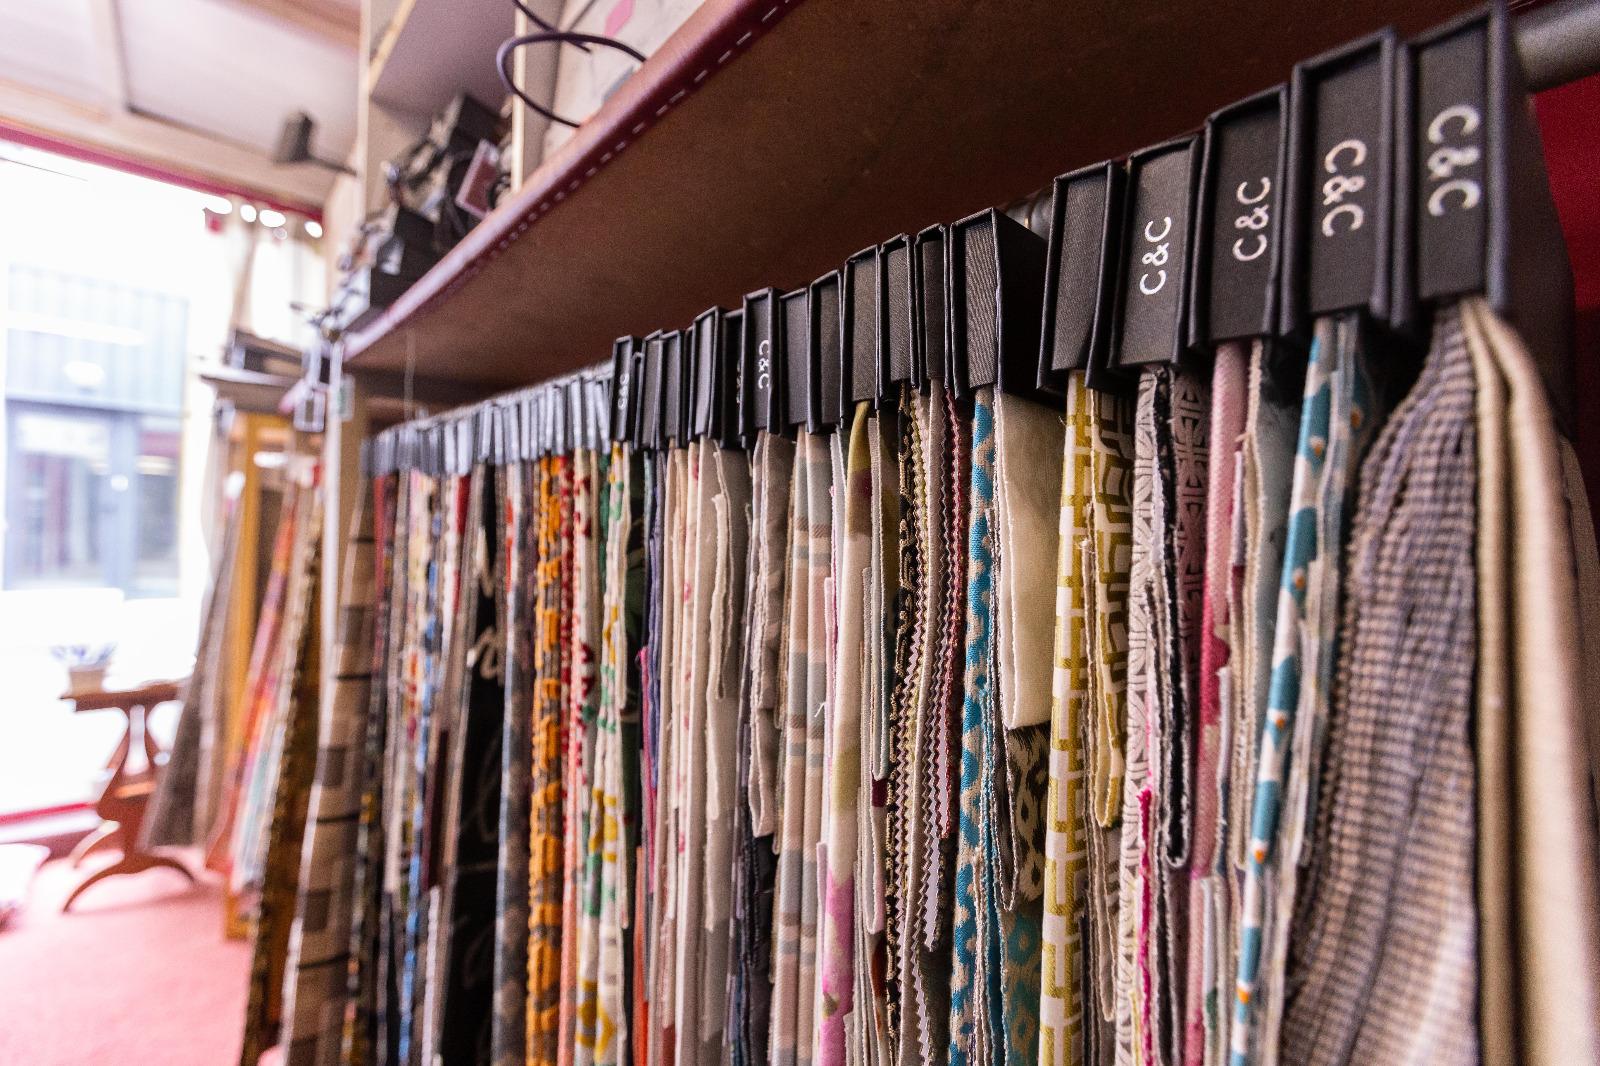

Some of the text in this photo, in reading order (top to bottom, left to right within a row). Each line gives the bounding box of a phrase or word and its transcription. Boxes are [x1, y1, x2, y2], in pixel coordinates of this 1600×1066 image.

[1322, 139, 1367, 237] C&C
[1428, 104, 1481, 217] C&C
[1139, 216, 1172, 295] C&C
[1232, 176, 1270, 261] C&C
[758, 339, 770, 389] C&C
